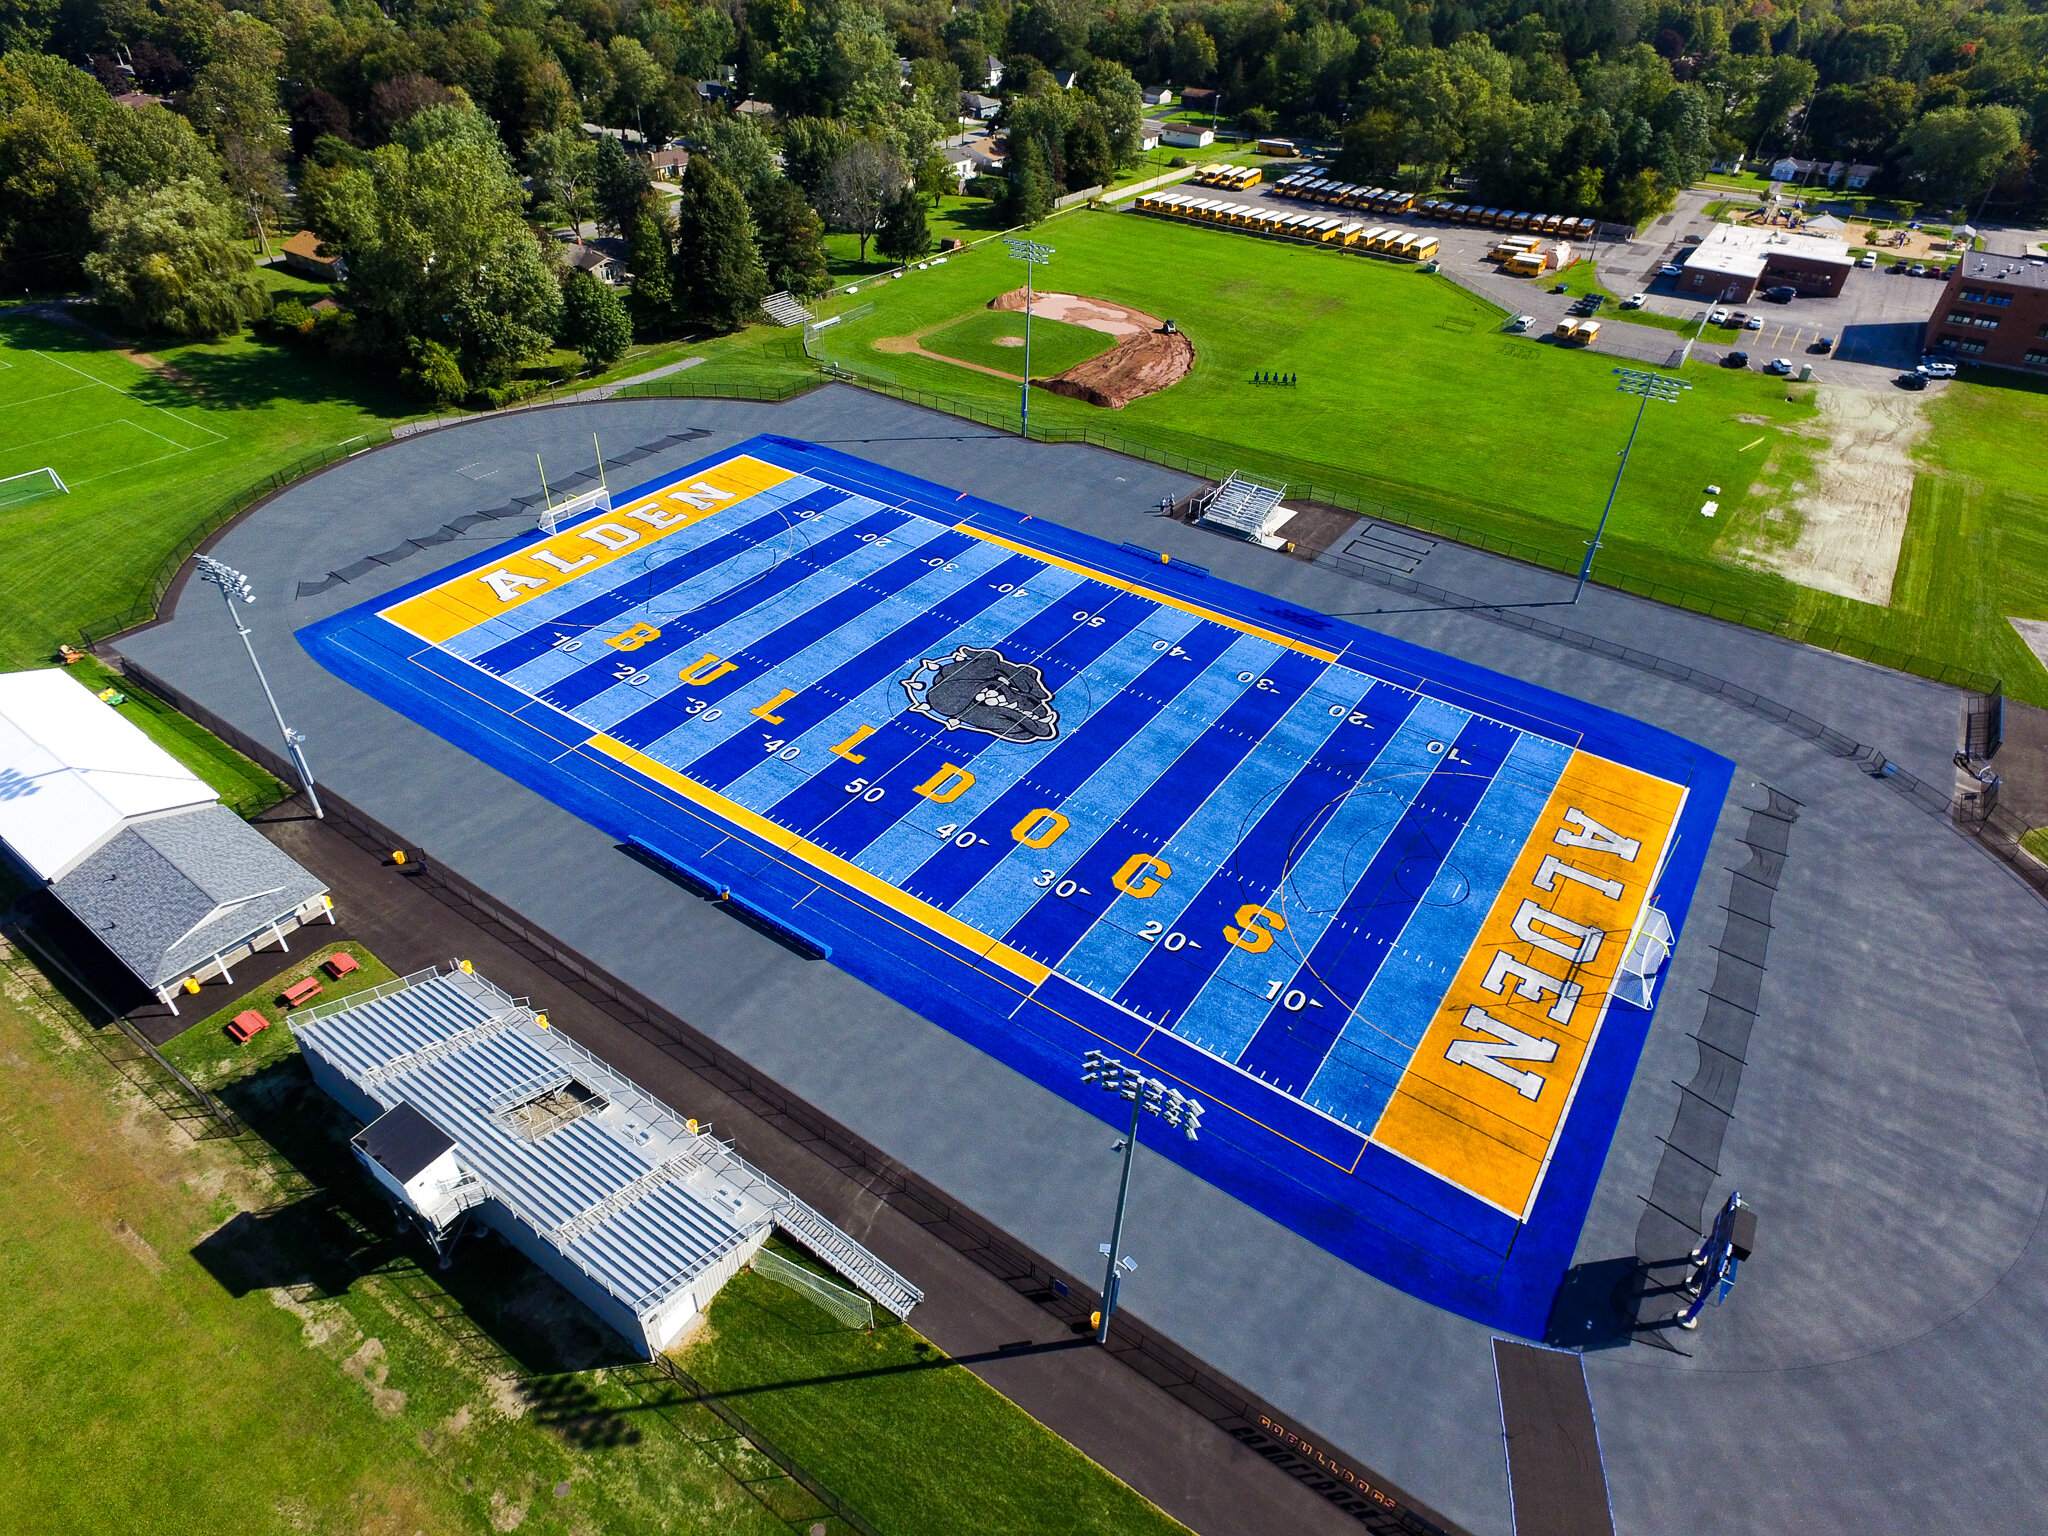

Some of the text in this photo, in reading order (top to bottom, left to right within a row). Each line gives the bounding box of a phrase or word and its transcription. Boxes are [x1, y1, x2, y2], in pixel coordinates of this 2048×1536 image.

[800, 510, 824, 522] 10
[478, 481, 738, 602] ALDEN
[862, 533, 892, 547] 20
[927, 557, 959, 572] 30
[997, 583, 1029, 598] 40
[1072, 610, 1106, 628] 50
[556, 634, 583, 654] 10
[1152, 639, 1187, 661] 40
[612, 664, 650, 686] 20
[1236, 670, 1275, 692] 30
[685, 700, 722, 722] 30
[1328, 704, 1368, 726] 20
[763, 737, 800, 761] 40
[1427, 740, 1464, 762] 10
[603, 621, 1285, 954] BULLDOGS
[845, 777, 886, 804] 50
[935, 822, 979, 849] 40
[1032, 868, 1078, 898] 30
[1137, 920, 1188, 952] 20
[1444, 806, 1642, 1103] ALDEN
[1265, 980, 1309, 1012] 10
